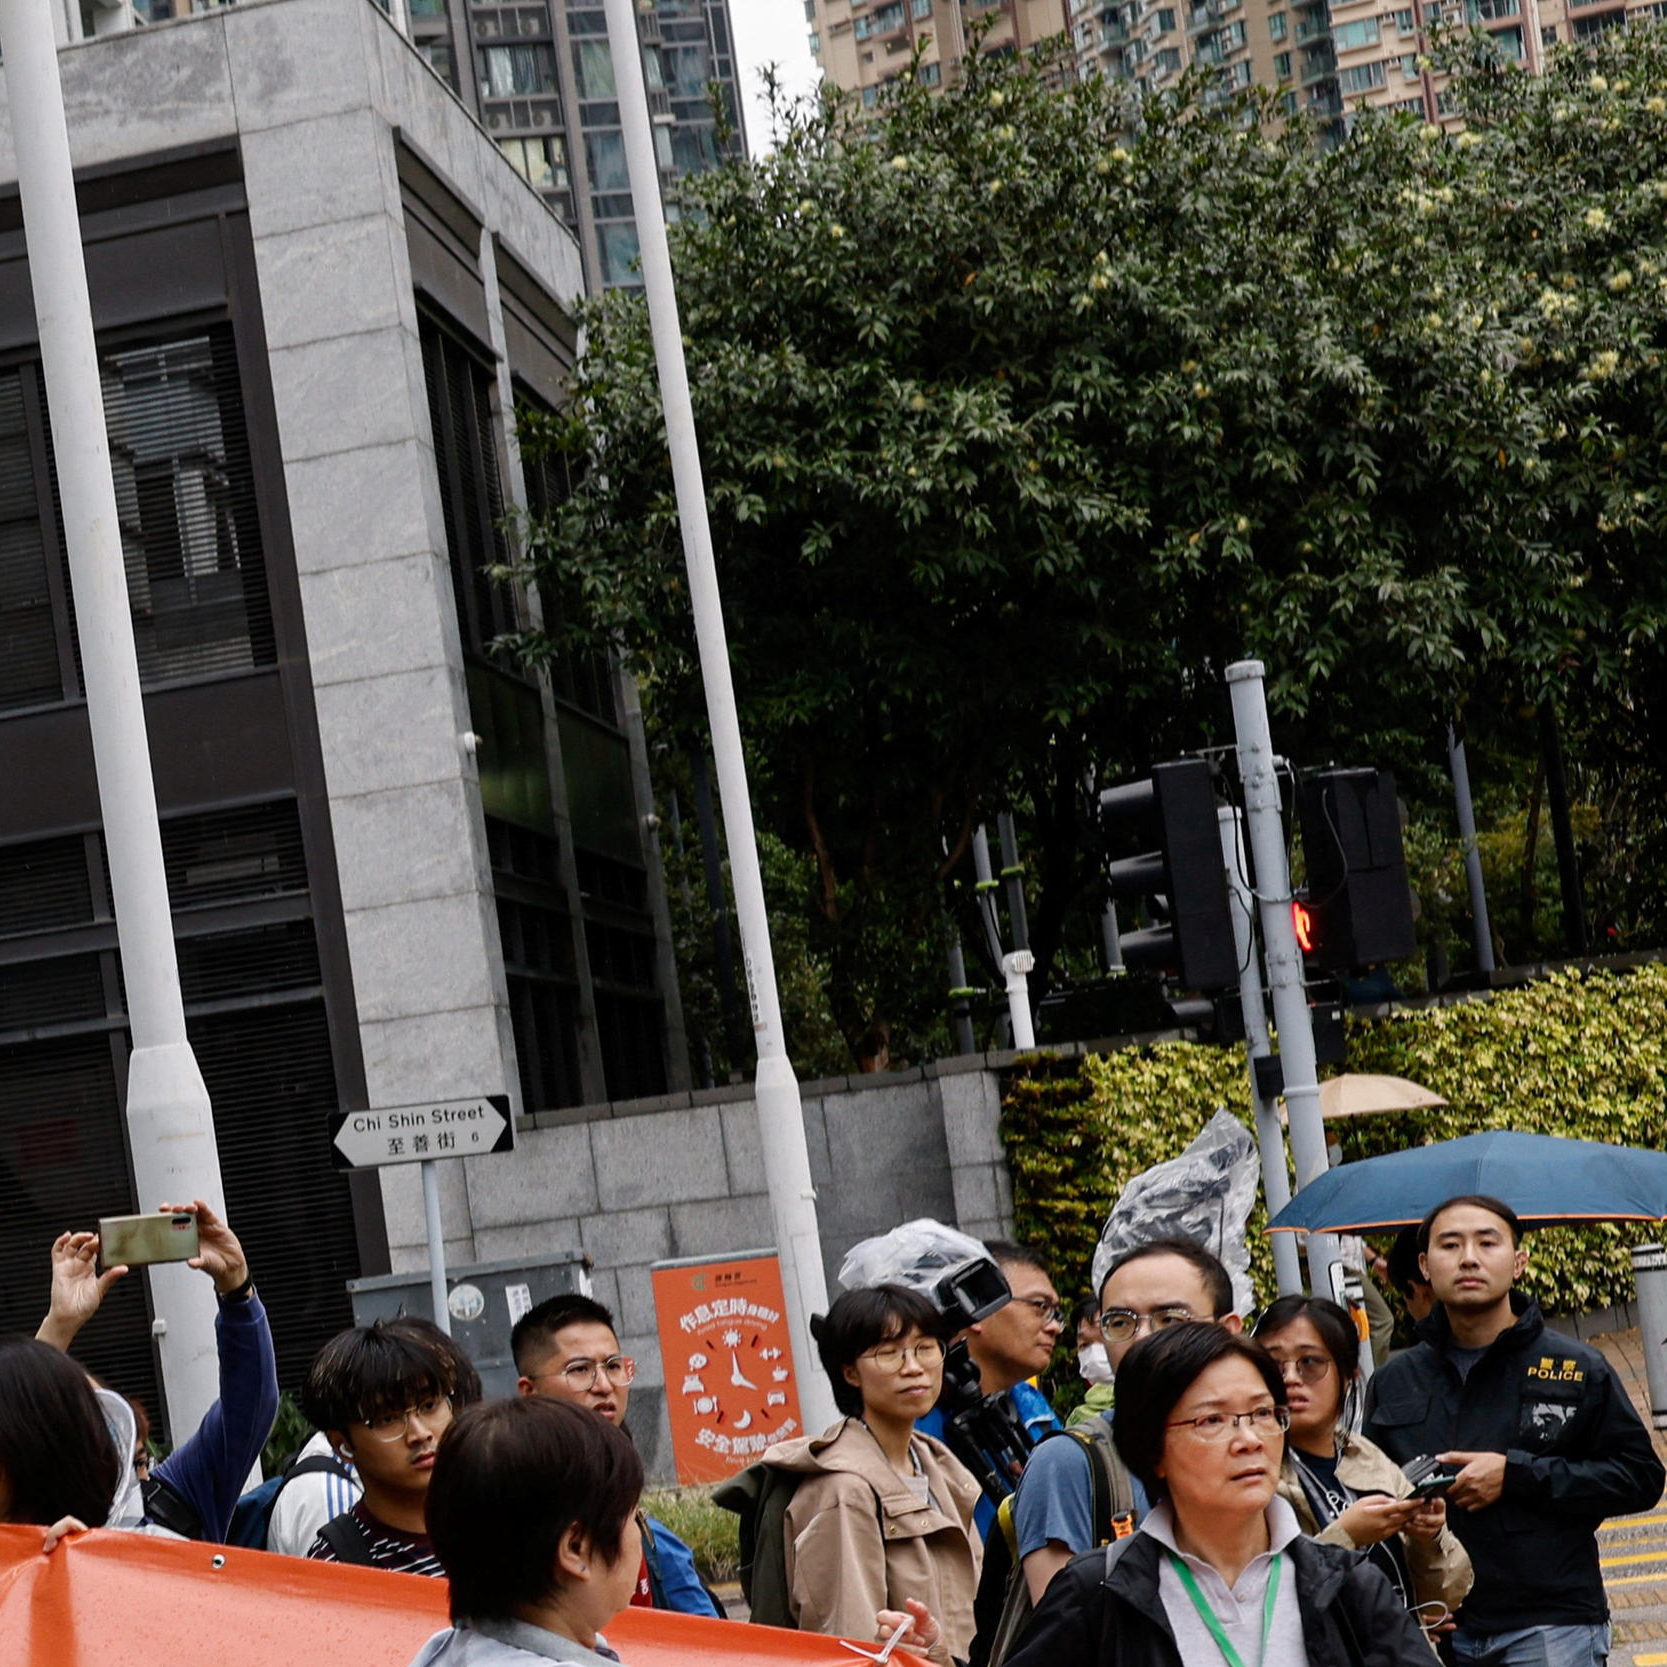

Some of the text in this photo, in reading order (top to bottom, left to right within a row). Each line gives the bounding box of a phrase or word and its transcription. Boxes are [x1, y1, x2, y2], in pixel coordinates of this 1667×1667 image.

[353, 1105, 485, 1133] Chi Shin Street
[387, 1130, 480, 1156] 至善街 6
[1527, 1366, 1585, 1382] POLICE
